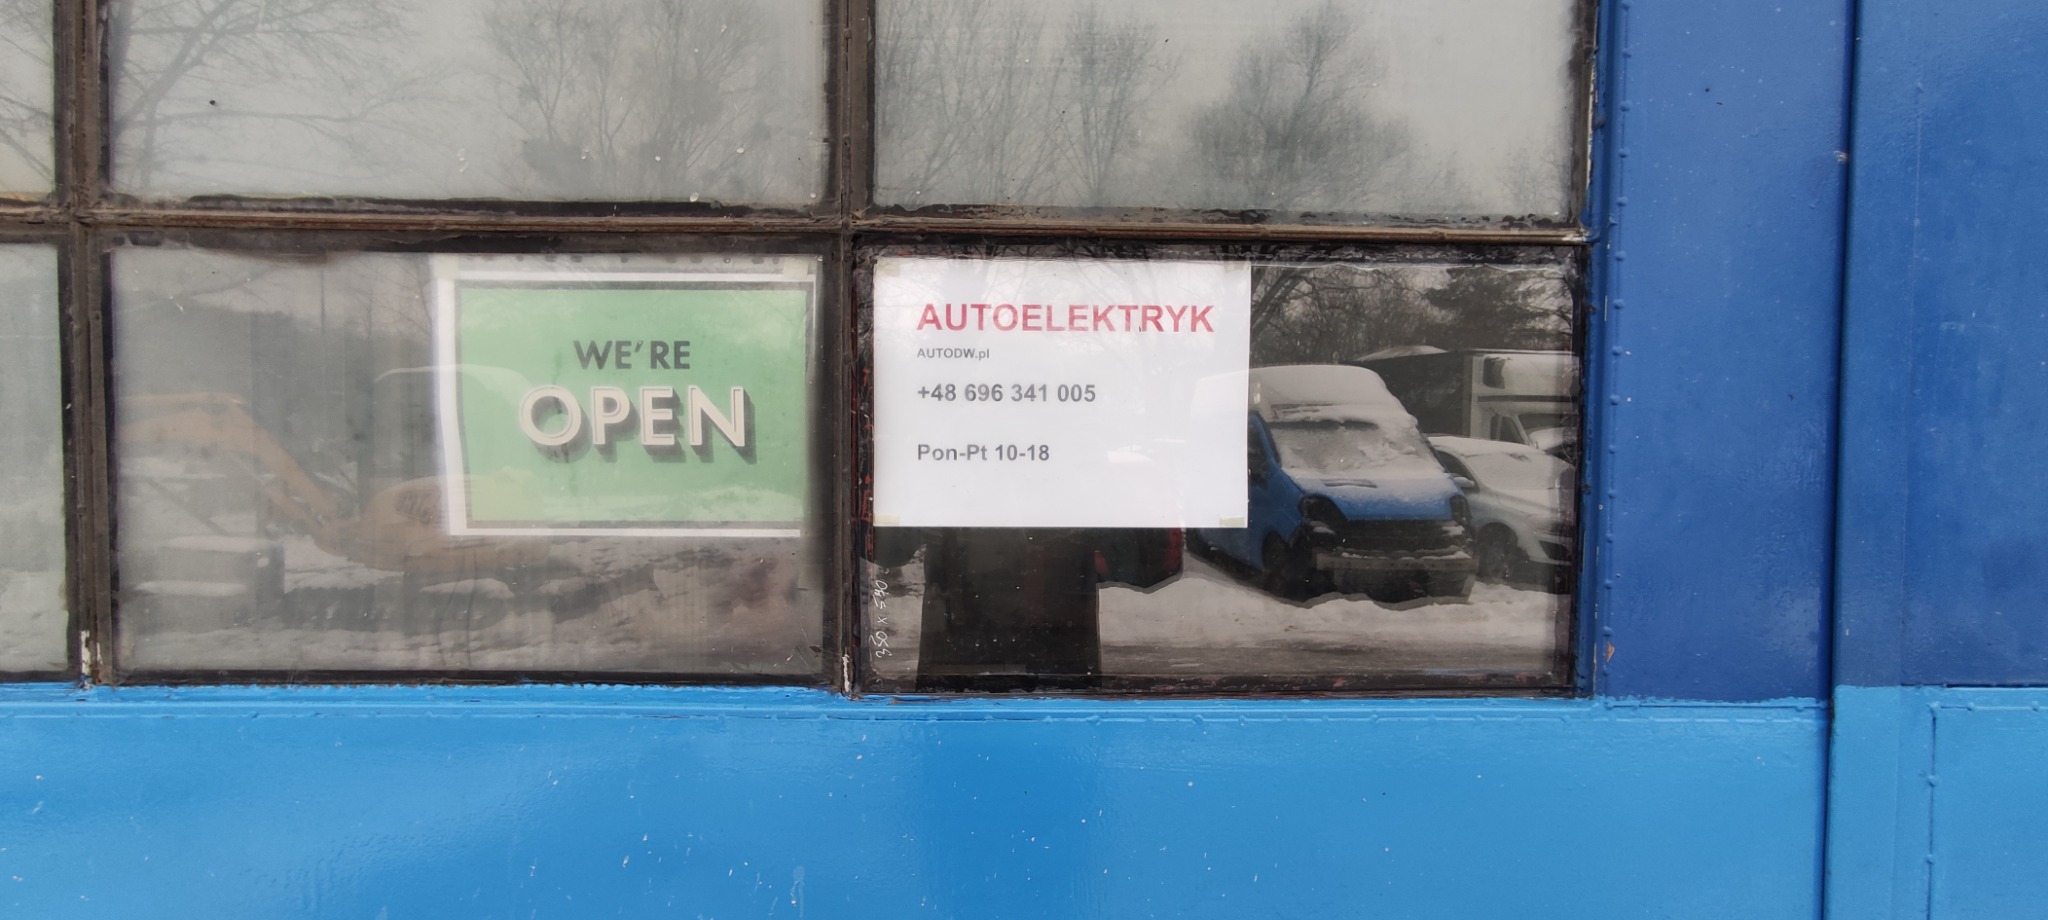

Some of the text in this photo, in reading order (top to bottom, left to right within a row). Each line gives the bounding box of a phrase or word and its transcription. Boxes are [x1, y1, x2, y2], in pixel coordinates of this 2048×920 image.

[917, 303, 1214, 333] AUTOELEKTRYK
[574, 340, 691, 370] WE'RE
[917, 348, 990, 361] AUTODW.pl
[917, 383, 1096, 402] +48 696 341 005
[519, 385, 753, 459] OPEN
[917, 443, 1050, 461] Pon-Pt 10-18
